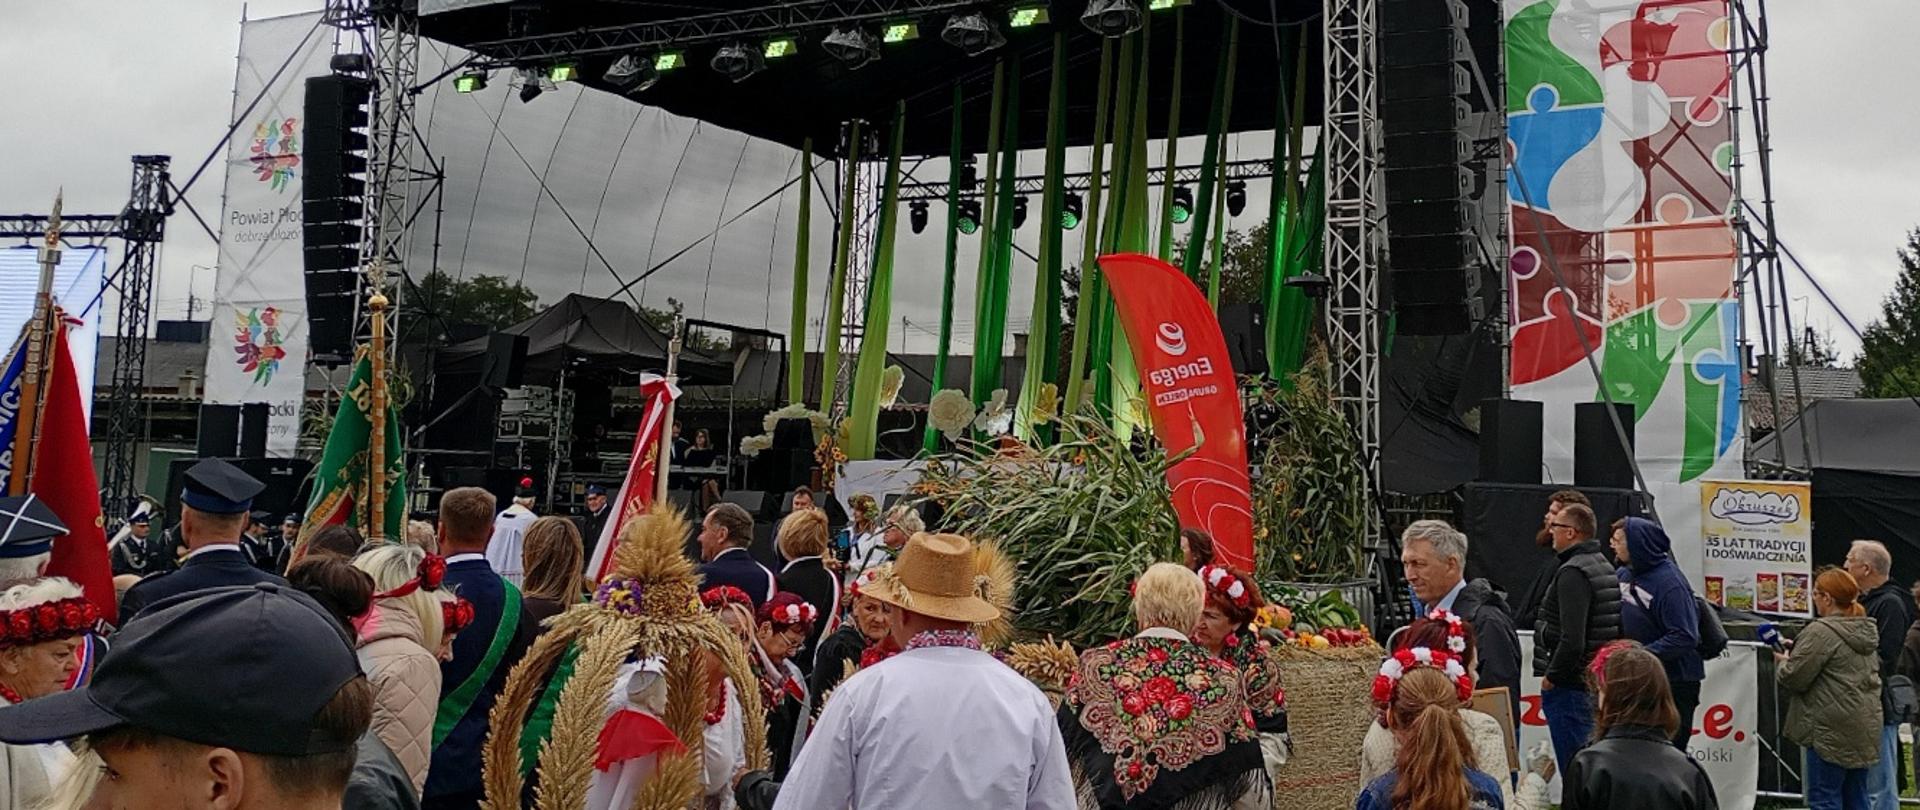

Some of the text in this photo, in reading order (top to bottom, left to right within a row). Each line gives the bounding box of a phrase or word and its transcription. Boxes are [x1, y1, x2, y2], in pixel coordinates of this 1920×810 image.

[231, 208, 274, 225] Powiat
[268, 400, 295, 416] ocki
[1723, 537, 1746, 549] LAT
[1749, 539, 1806, 553] TRADYCJI
[1705, 547, 1807, 563] I DOŚWIADCZENIA
